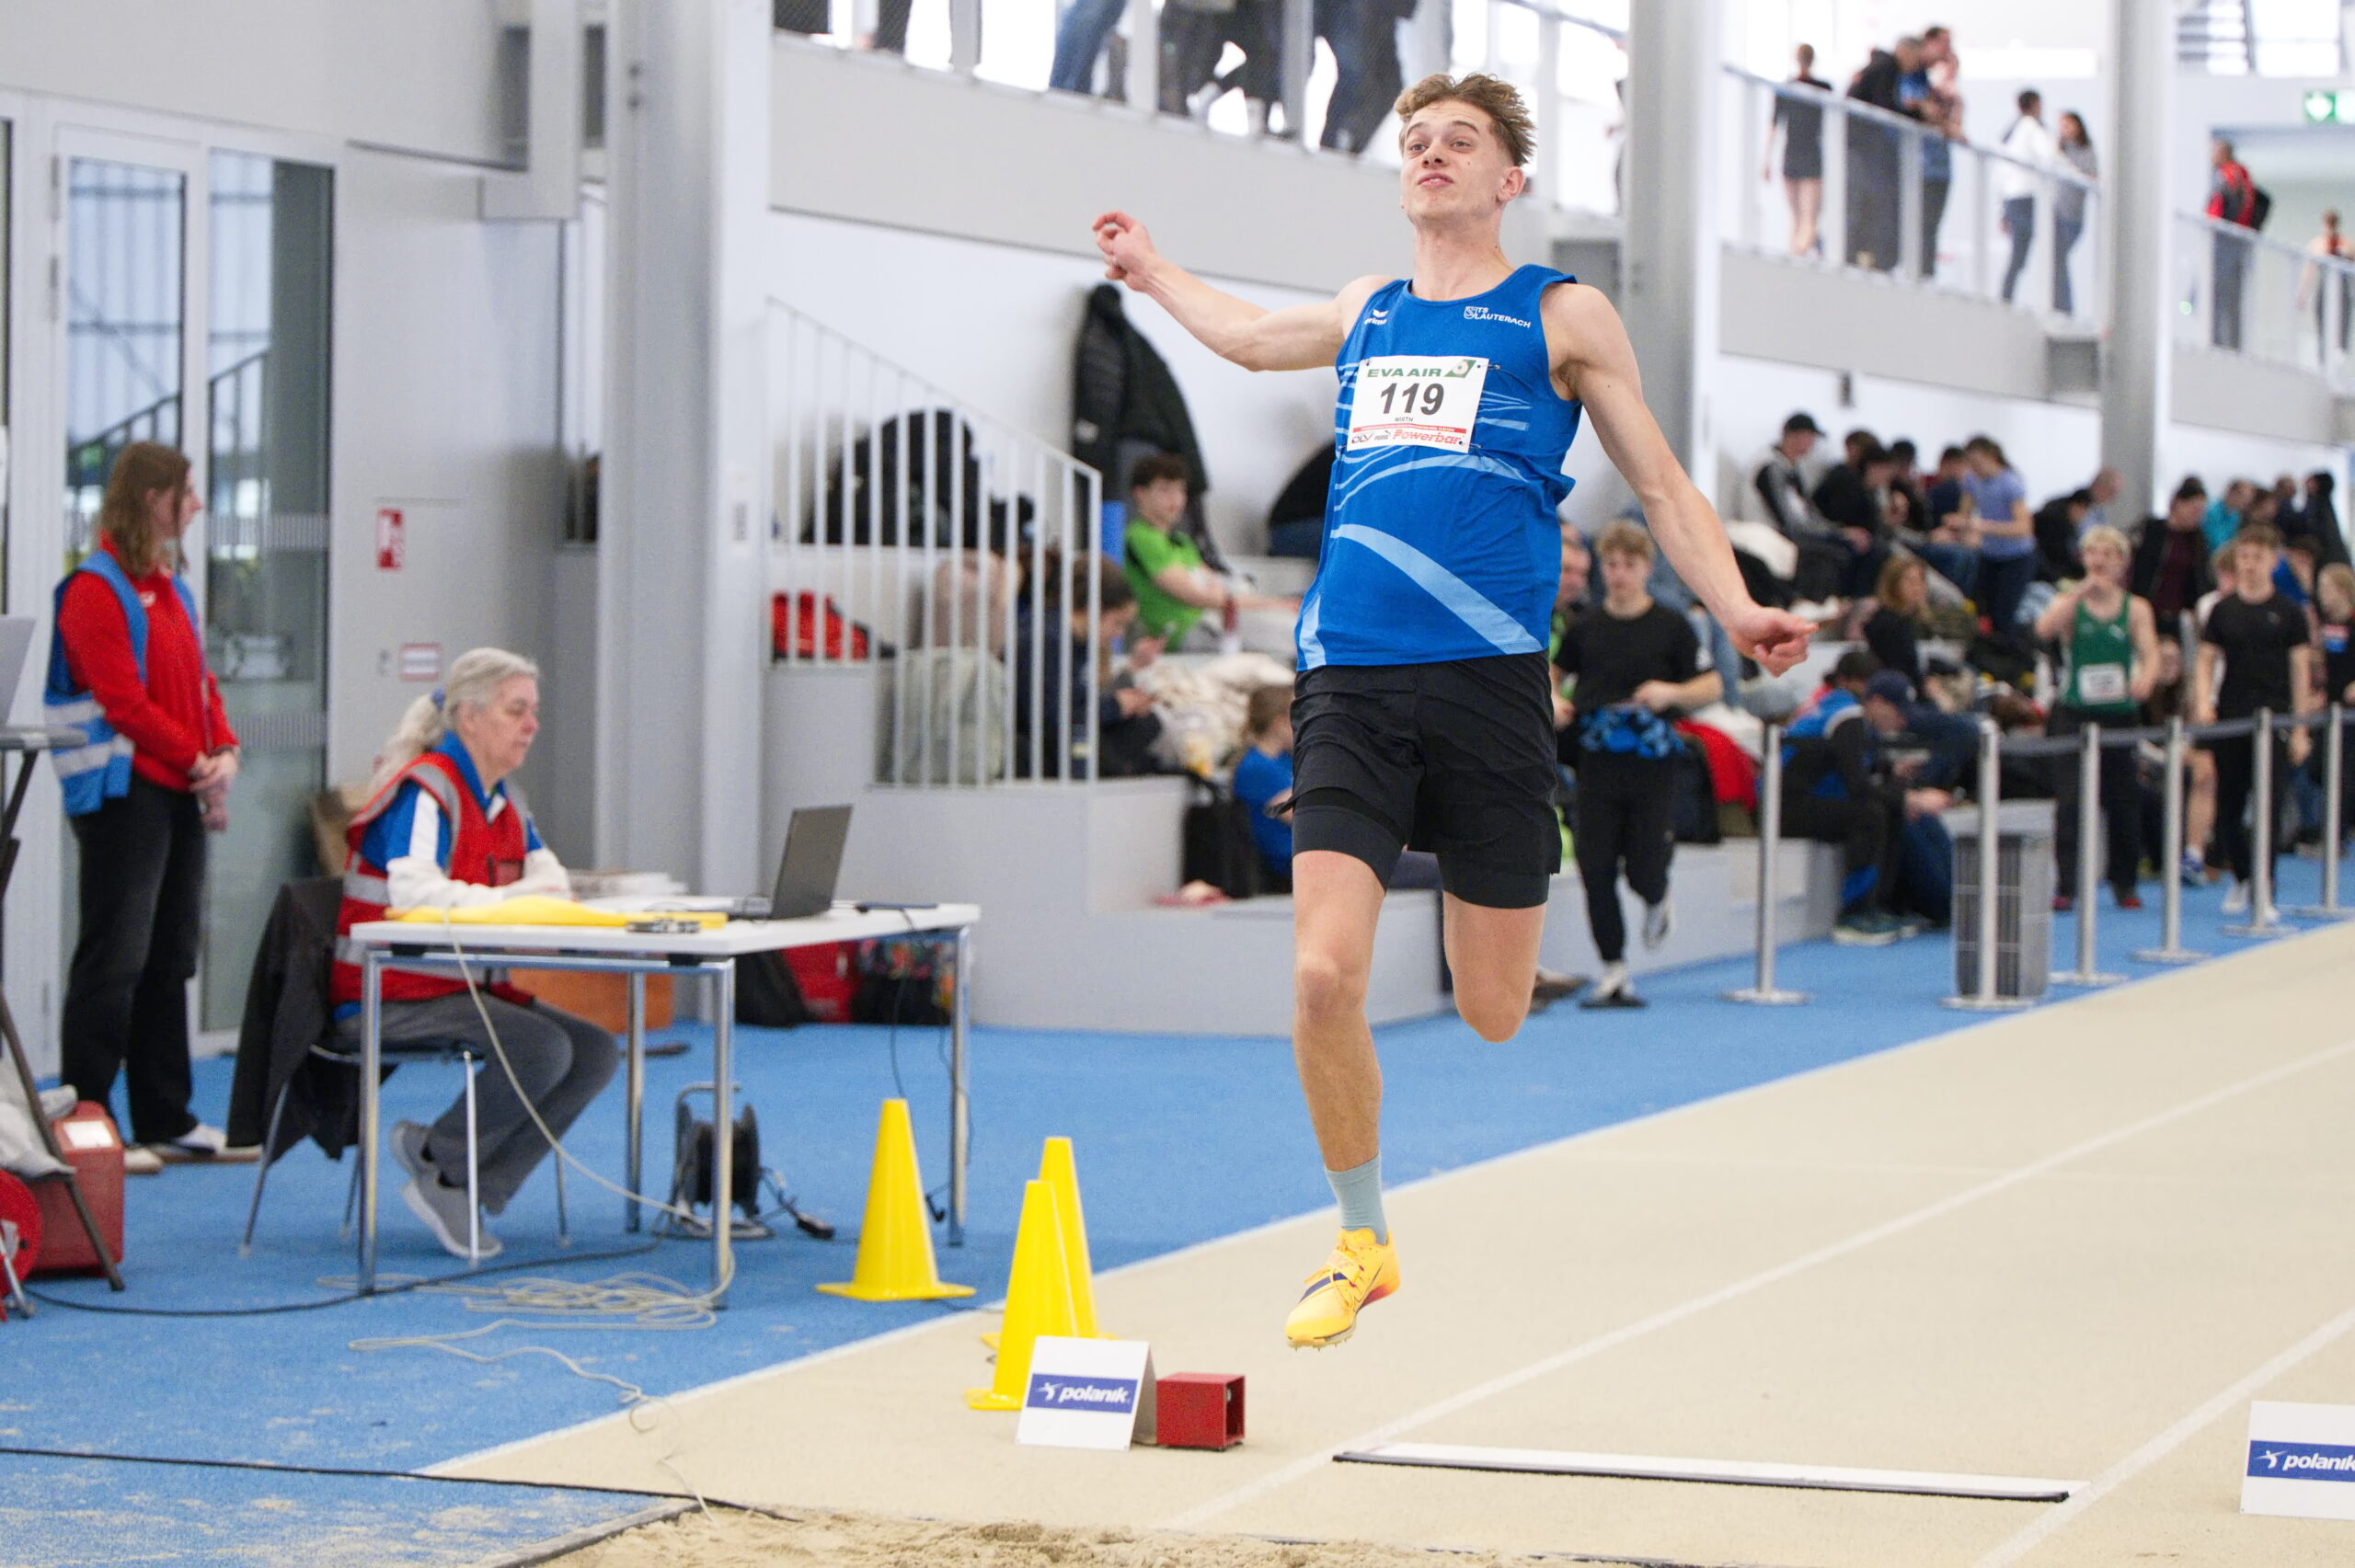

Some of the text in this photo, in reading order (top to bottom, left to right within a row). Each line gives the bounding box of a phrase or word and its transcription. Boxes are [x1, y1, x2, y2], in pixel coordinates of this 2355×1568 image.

[1474, 314, 1531, 328] LAUTERACH
[1367, 368, 1442, 378] EVA AIR
[1380, 383, 1444, 416] 119
[1392, 429, 1463, 445] Powerbar
[1058, 1385, 1129, 1403] polanik
[2282, 1453, 2355, 1471] polanik
